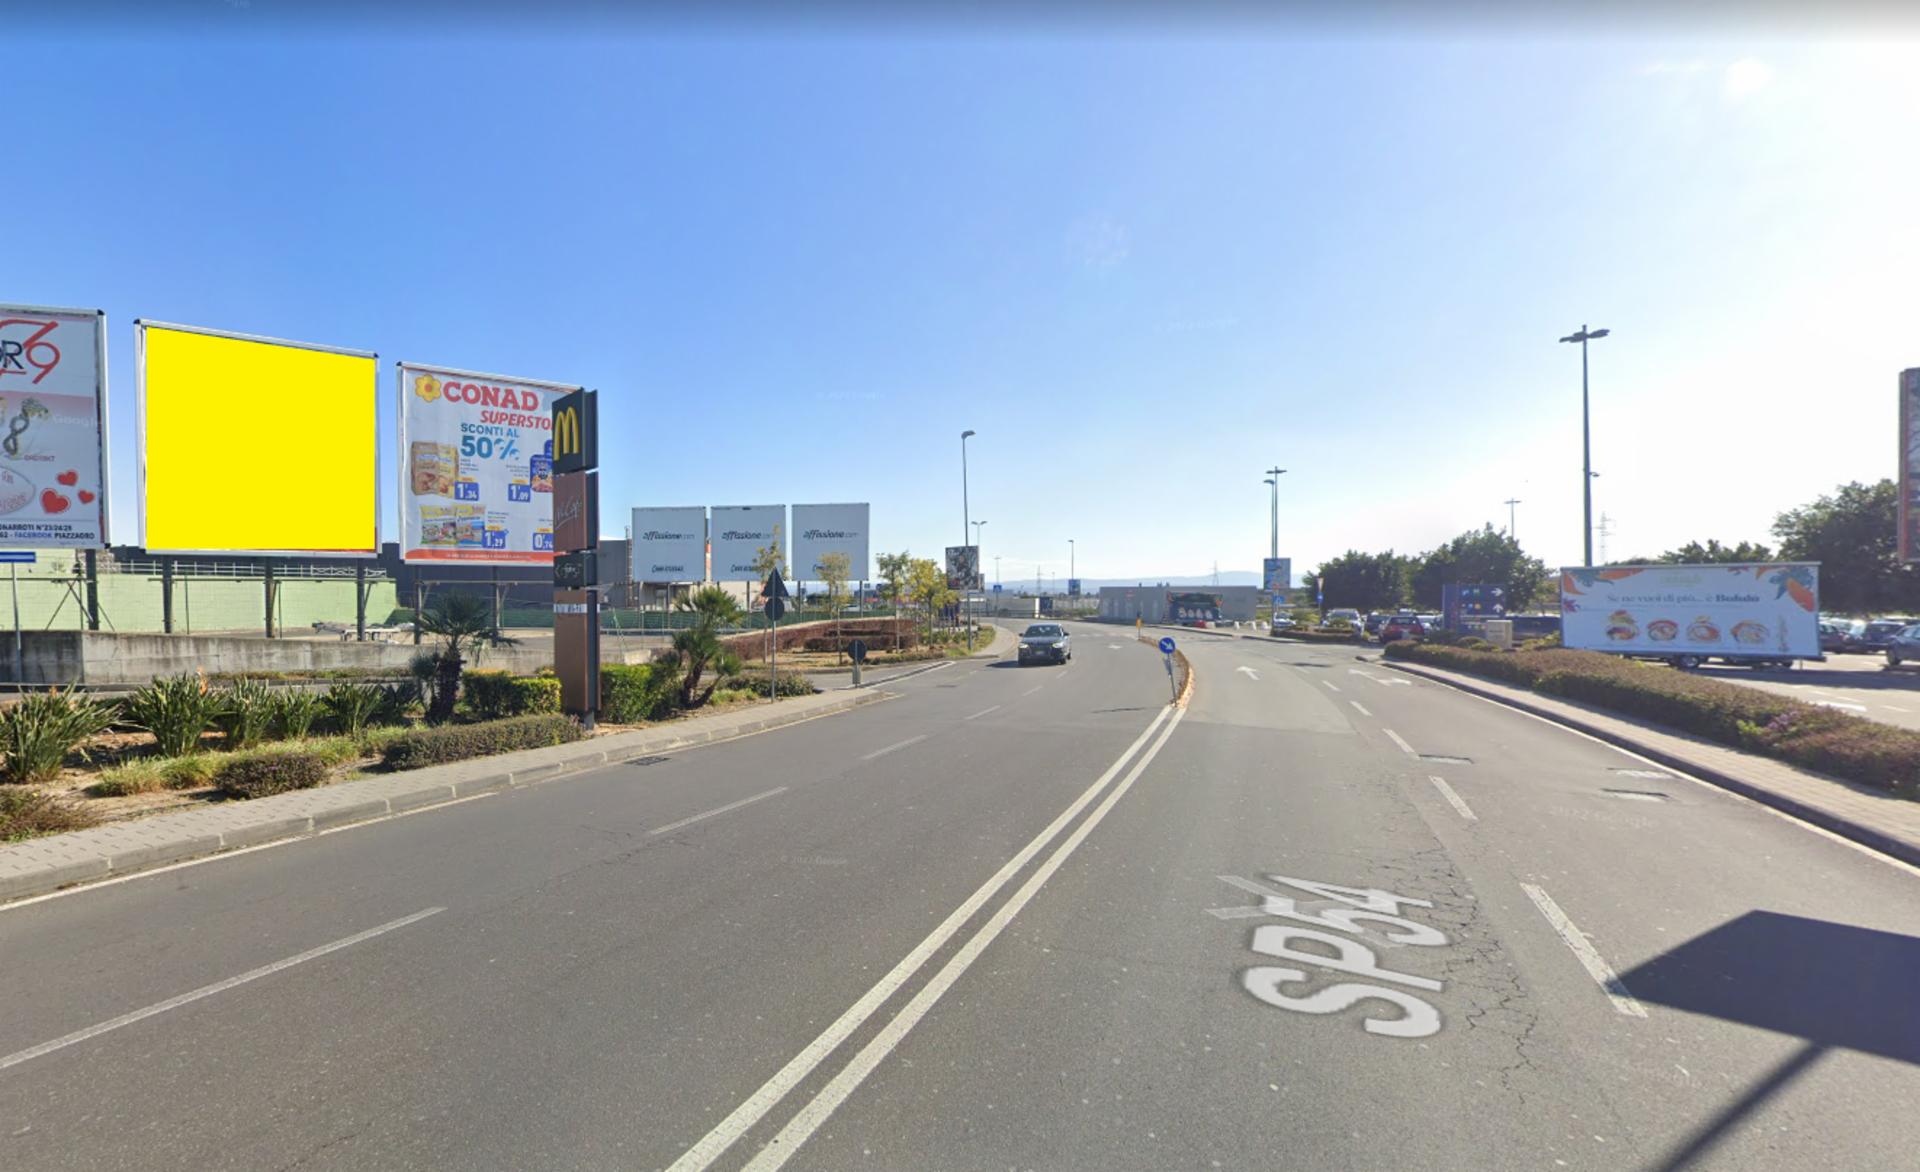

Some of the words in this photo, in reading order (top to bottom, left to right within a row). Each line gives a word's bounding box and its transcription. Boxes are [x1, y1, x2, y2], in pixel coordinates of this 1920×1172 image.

[443, 381, 539, 411] CONAD
[460, 422, 504, 437] SCONTI
[507, 429, 520, 438] AL
[480, 409, 553, 430] SUPERSTO
[460, 435, 520, 461] 50%
